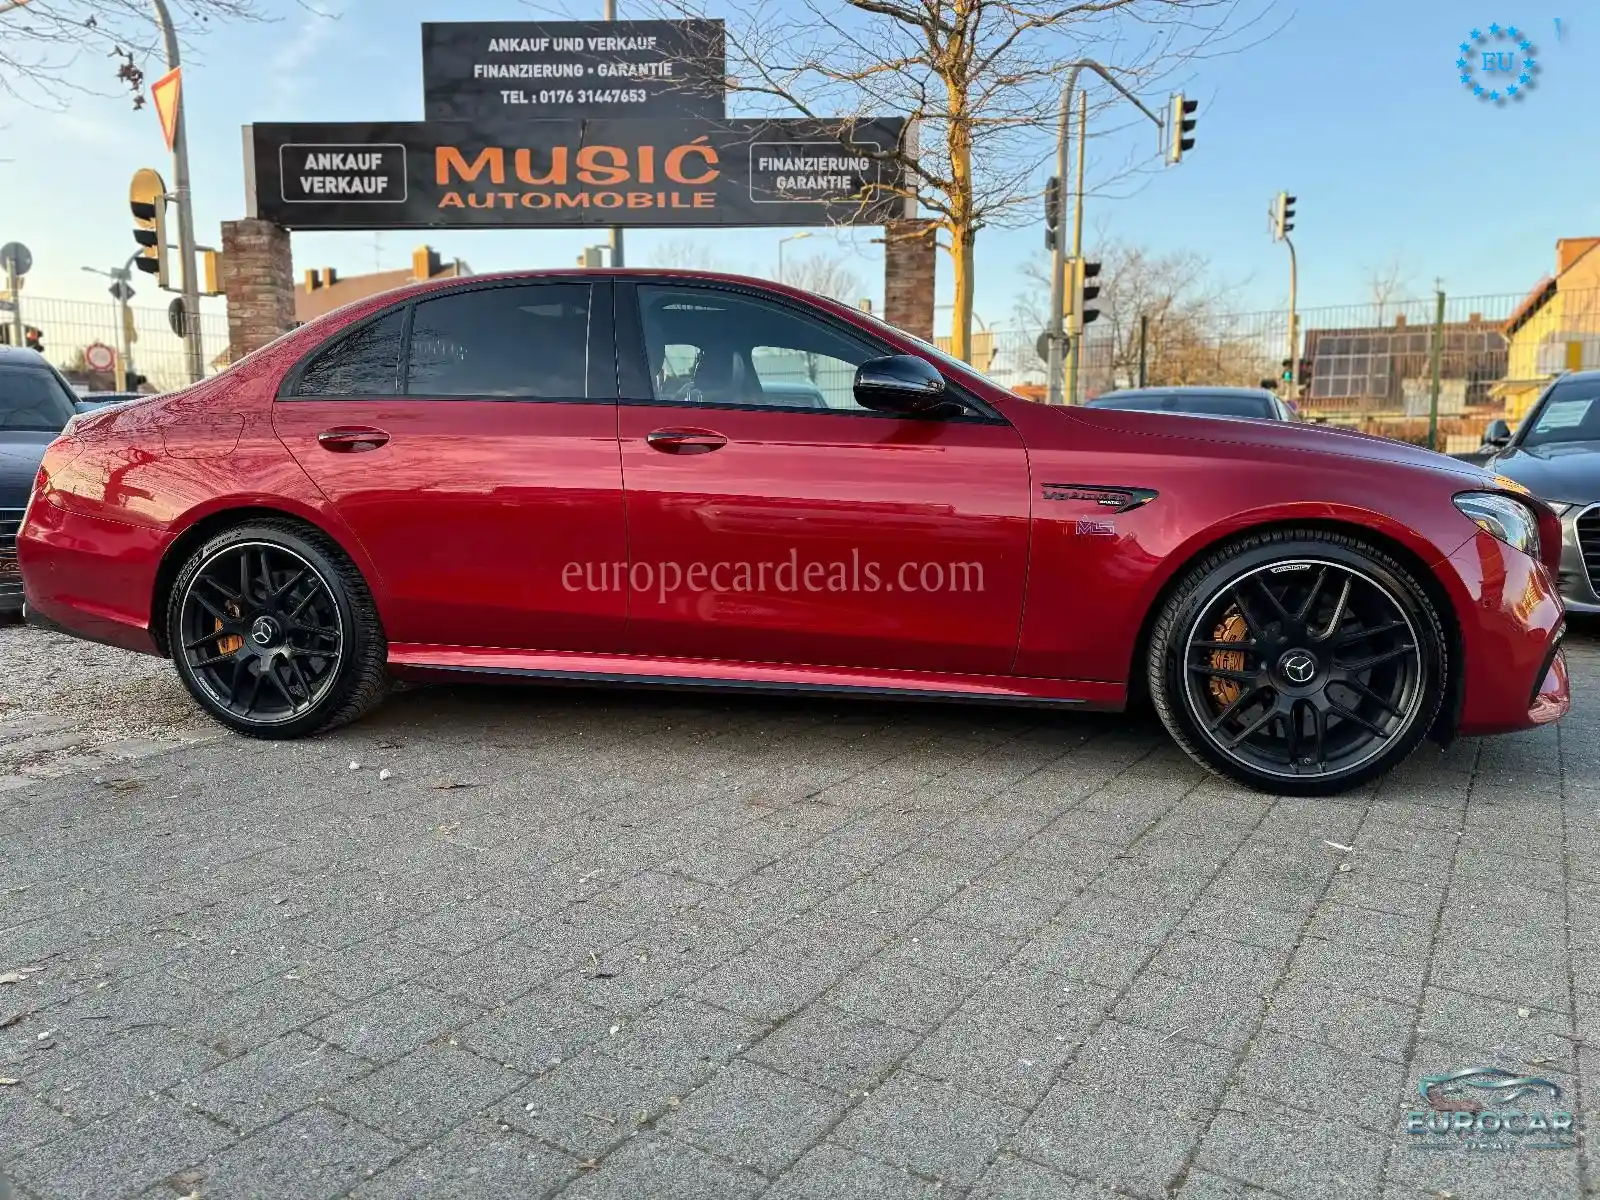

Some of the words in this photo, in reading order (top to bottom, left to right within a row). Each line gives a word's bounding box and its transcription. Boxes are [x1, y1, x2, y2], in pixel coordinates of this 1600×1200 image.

[488, 38, 549, 52] ANKAUF
[553, 37, 584, 51] UND
[587, 36, 657, 50] VERKAUF
[474, 64, 584, 78] FINANZIERUNG
[597, 63, 673, 77] GARANTIE
[501, 90, 528, 104] TEL
[539, 90, 574, 103] 0176
[577, 89, 646, 103] 31447653
[304, 153, 382, 171] ANKAUF
[435, 136, 720, 186] MUSIĆ
[758, 157, 870, 171] FINANZIERUNG
[300, 176, 388, 194] VERKAUF
[776, 175, 851, 189] GARANTIE
[438, 192, 718, 209] AUTOMOBILE
